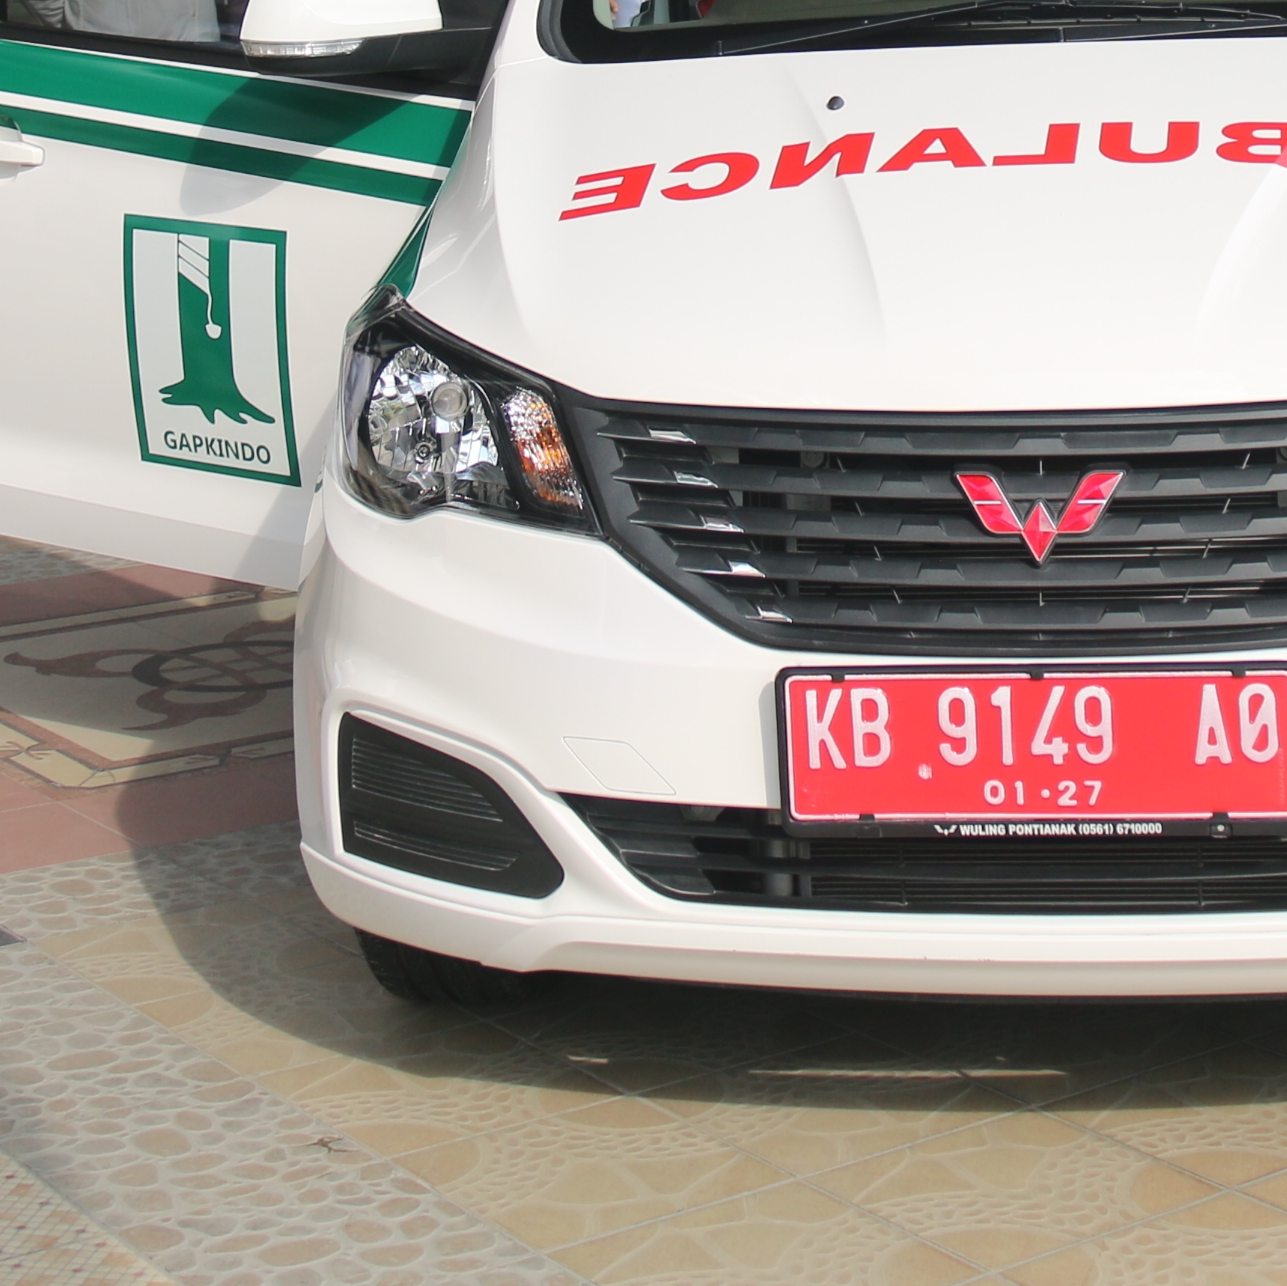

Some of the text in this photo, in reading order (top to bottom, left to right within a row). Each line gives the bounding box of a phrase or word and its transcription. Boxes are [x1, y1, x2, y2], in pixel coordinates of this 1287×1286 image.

[164, 430, 271, 464] GAPKINDO
[805, 687, 892, 769] KB
[937, 685, 1114, 766] 9149
[959, 823, 1162, 835] WULING PONTIANAK (0561) 6710000
